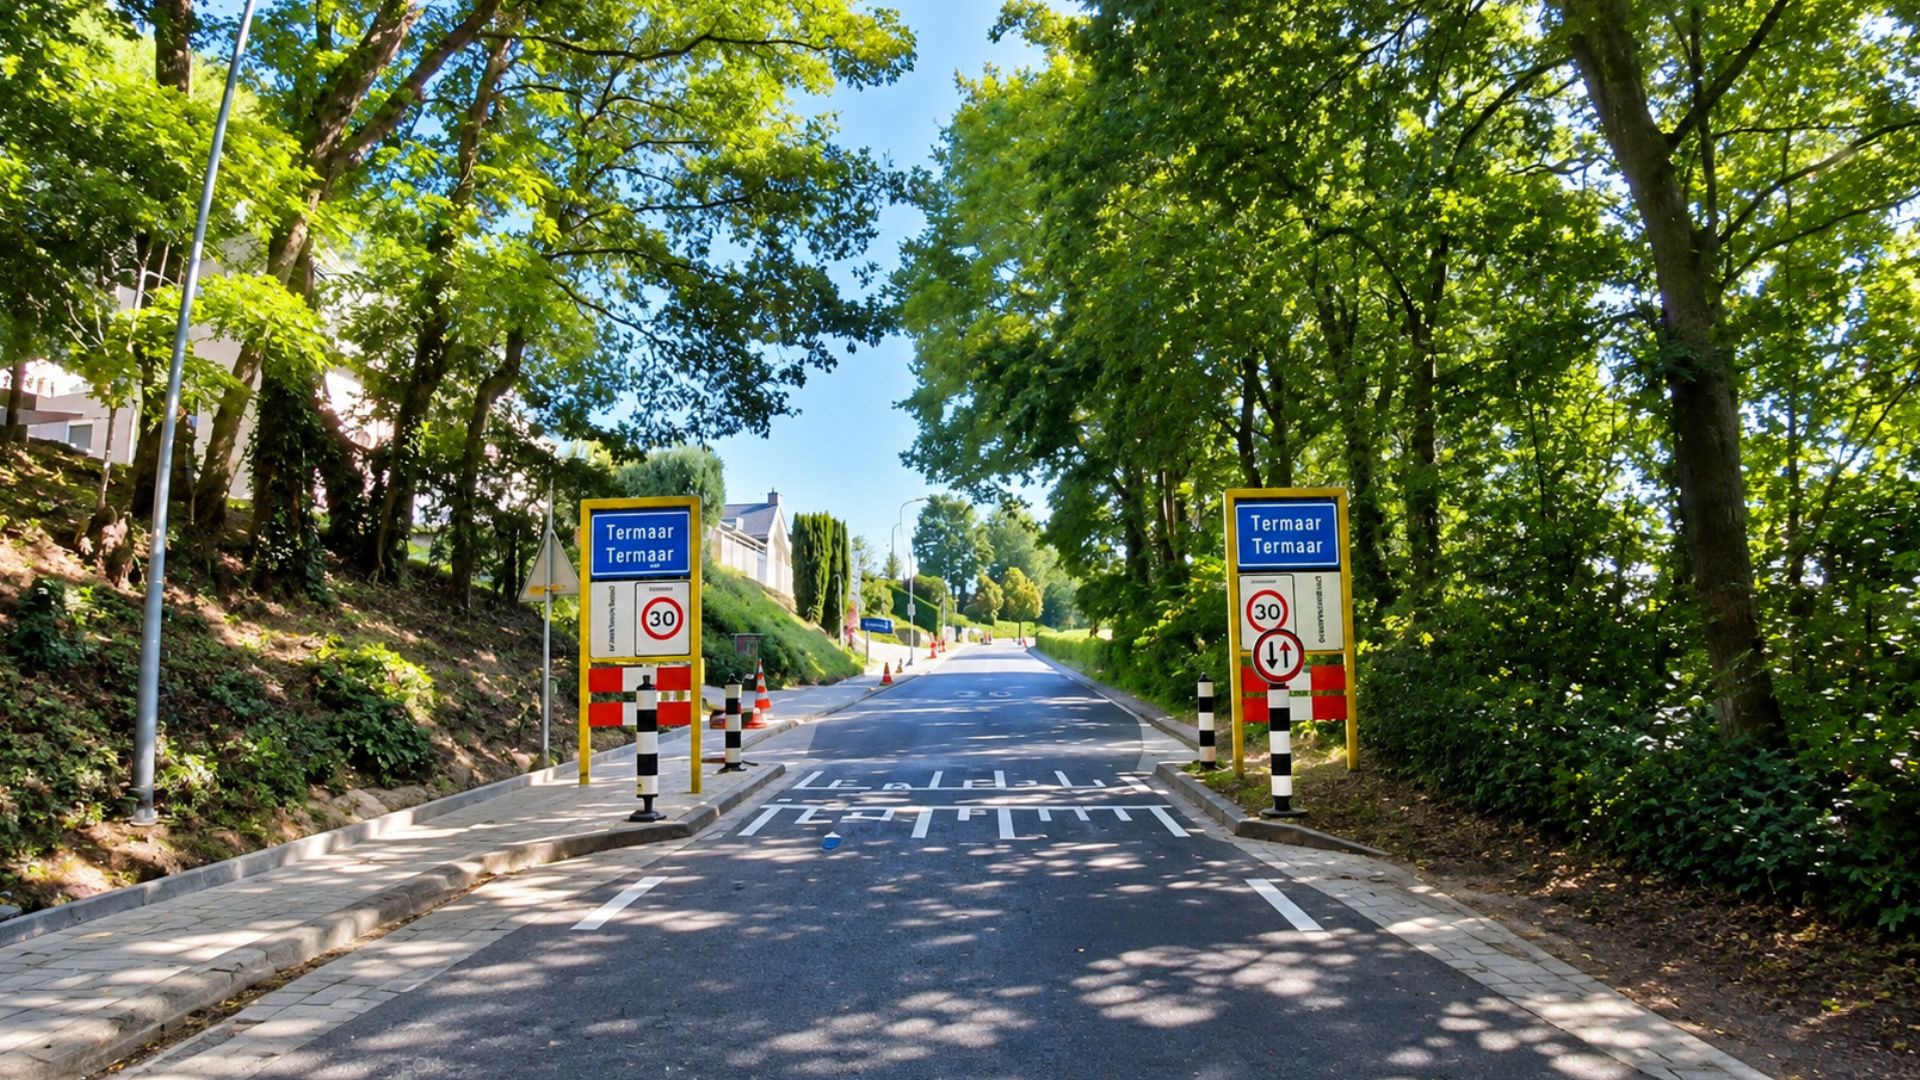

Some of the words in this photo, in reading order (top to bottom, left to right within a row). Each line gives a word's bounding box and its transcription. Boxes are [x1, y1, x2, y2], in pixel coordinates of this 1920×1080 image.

[1251, 515, 1322, 531] Termaar
[606, 524, 673, 540] Termaar
[1252, 538, 1323, 554] Termaar
[606, 547, 673, 563] Termaar
[649, 611, 675, 627] 30
[1254, 604, 1280, 620] 30
